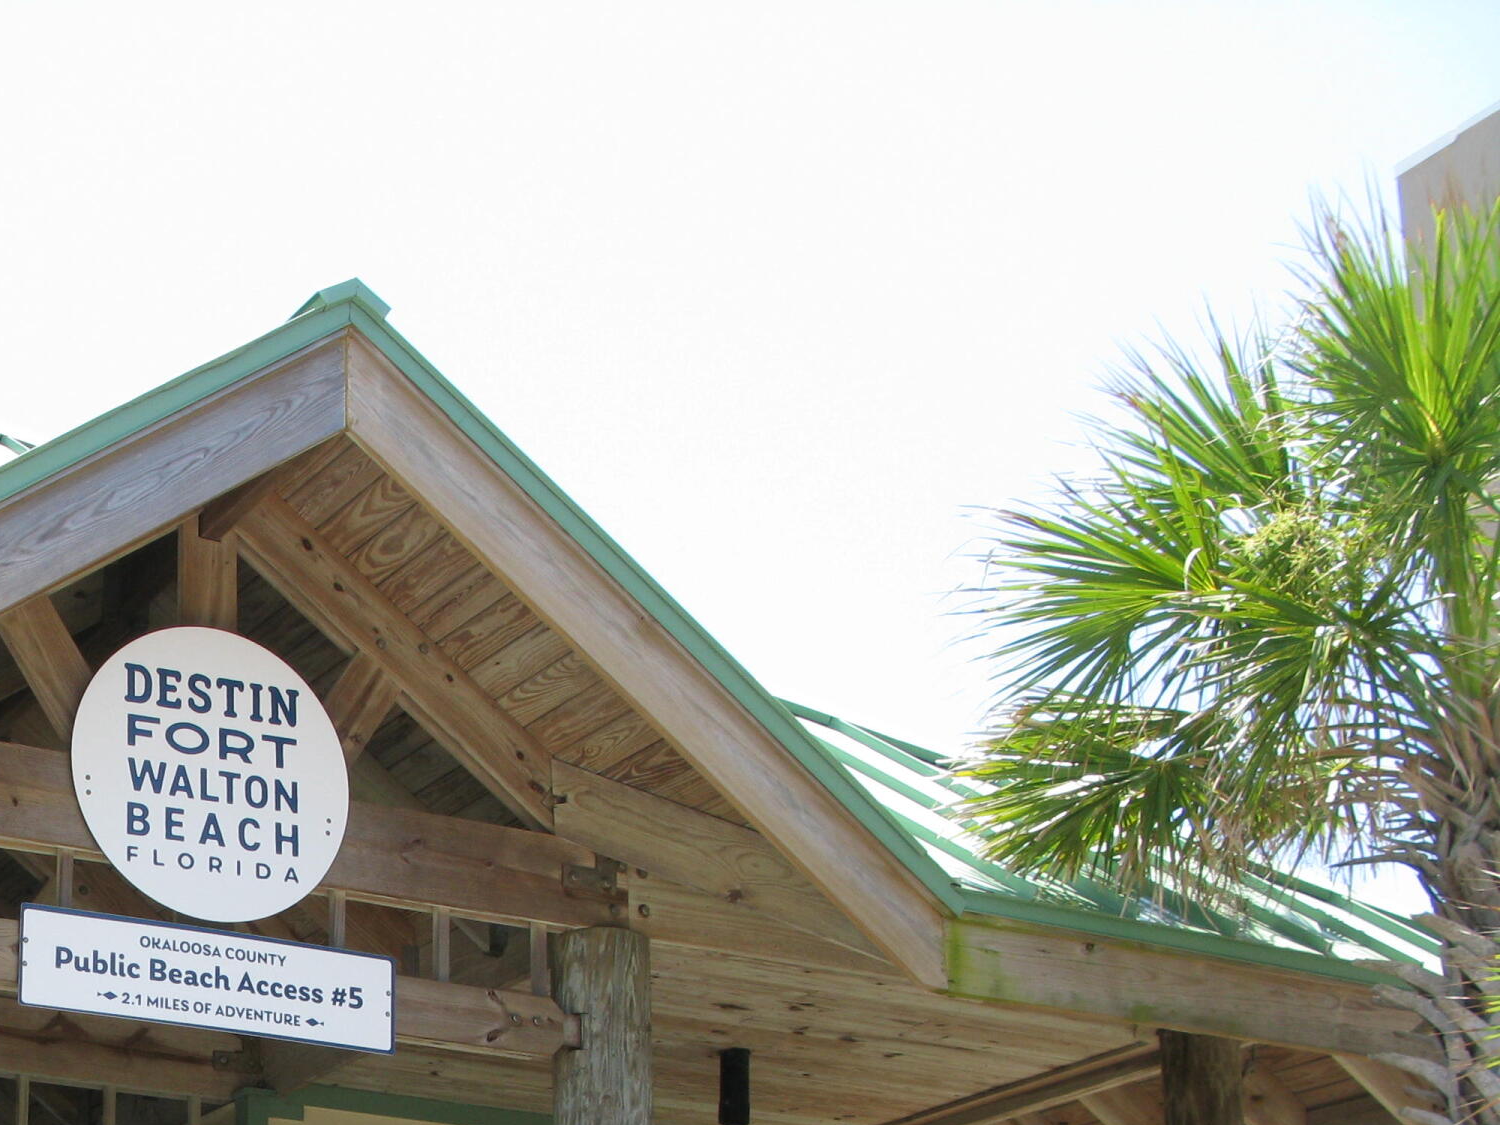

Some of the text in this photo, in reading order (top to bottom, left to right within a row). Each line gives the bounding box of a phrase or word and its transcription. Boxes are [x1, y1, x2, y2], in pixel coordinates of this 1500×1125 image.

[123, 662, 300, 728] DESTIN
[126, 713, 298, 769] FORT
[127, 757, 299, 814] WALTON
[126, 801, 300, 857] BEACH
[126, 845, 300, 884] FLORIDA
[54, 945, 364, 1009] Public Beach Access #5
[139, 935, 287, 967] OKALOOSA COUNTY
[121, 992, 301, 1027] 2.1 MILES OF ADVENTURE
